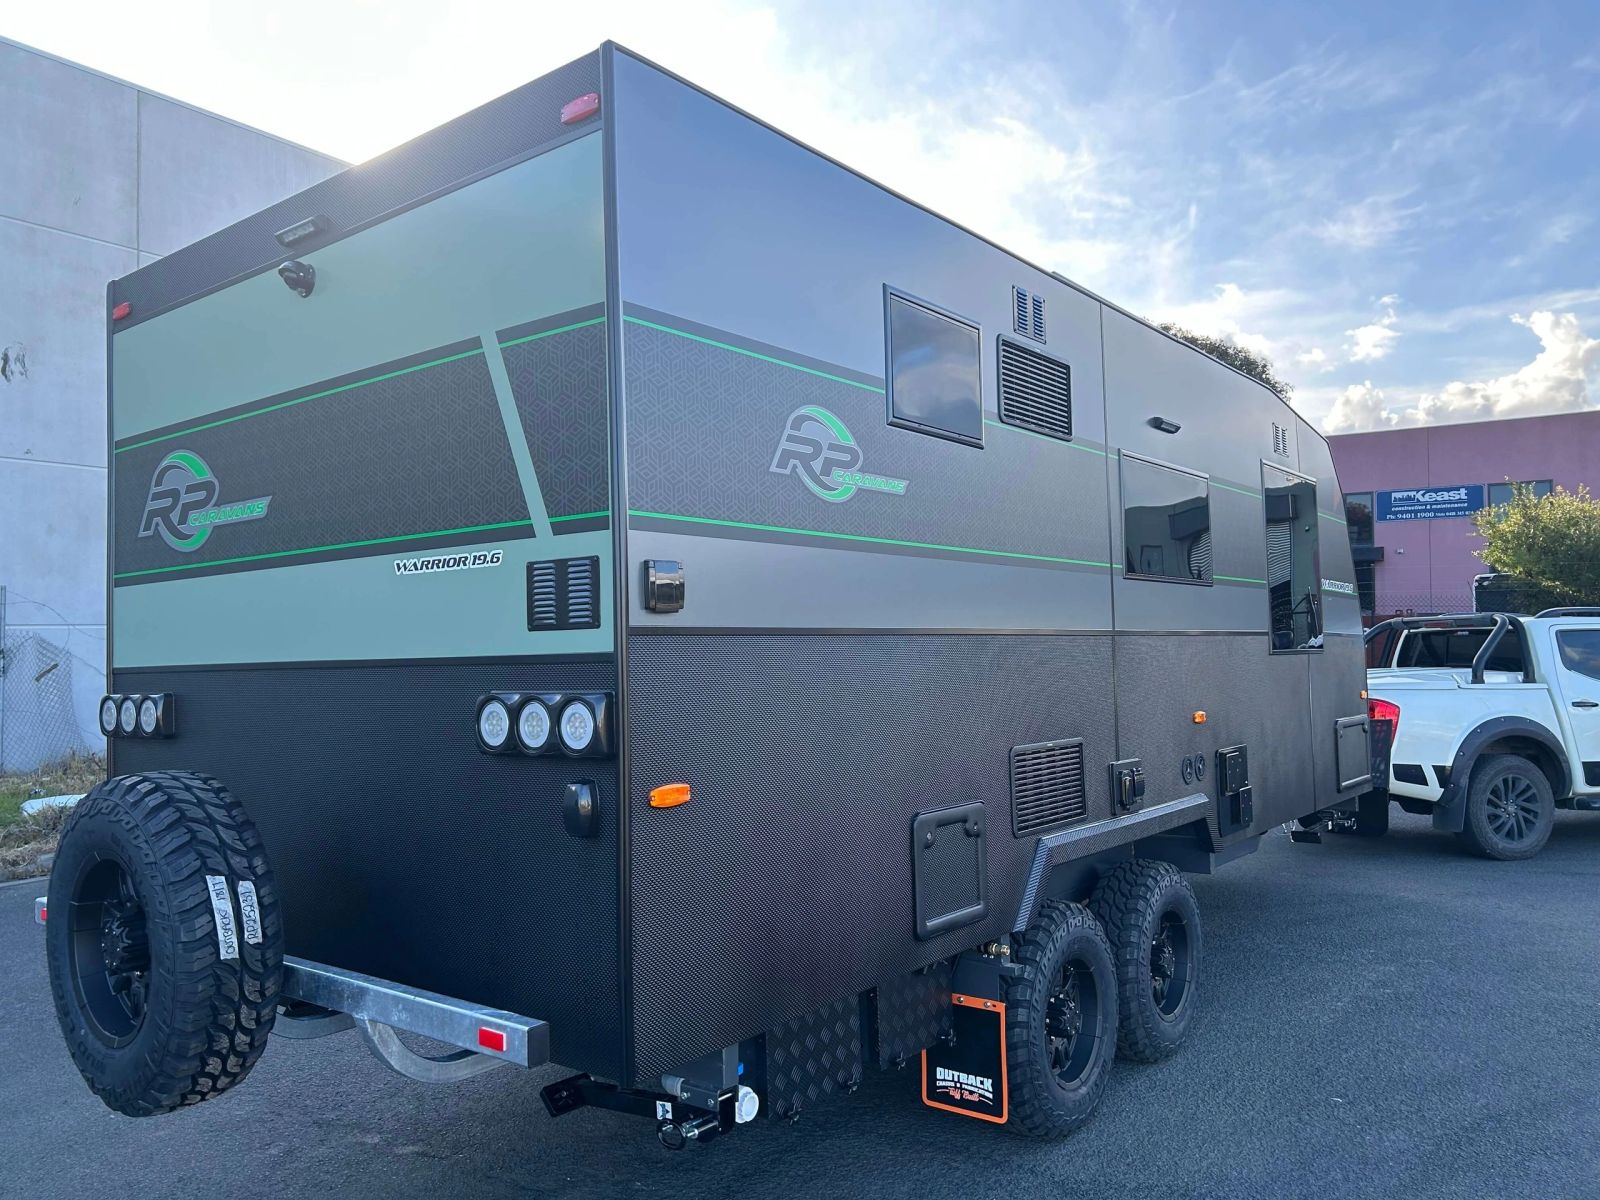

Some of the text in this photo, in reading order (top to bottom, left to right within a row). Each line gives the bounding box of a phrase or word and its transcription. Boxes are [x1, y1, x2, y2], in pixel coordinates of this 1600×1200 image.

[769, 428, 863, 493] RP
[831, 470, 907, 494] CARAVANS
[1415, 487, 1468, 502] Keast
[138, 474, 219, 543] RP
[188, 501, 266, 527] CARAVANS
[395, 551, 502, 574] WARRIOR 19.6
[240, 890, 260, 940] RP25231
[218, 909, 236, 955] OUTBACK
[936, 1066, 993, 1093] OUTBACK
